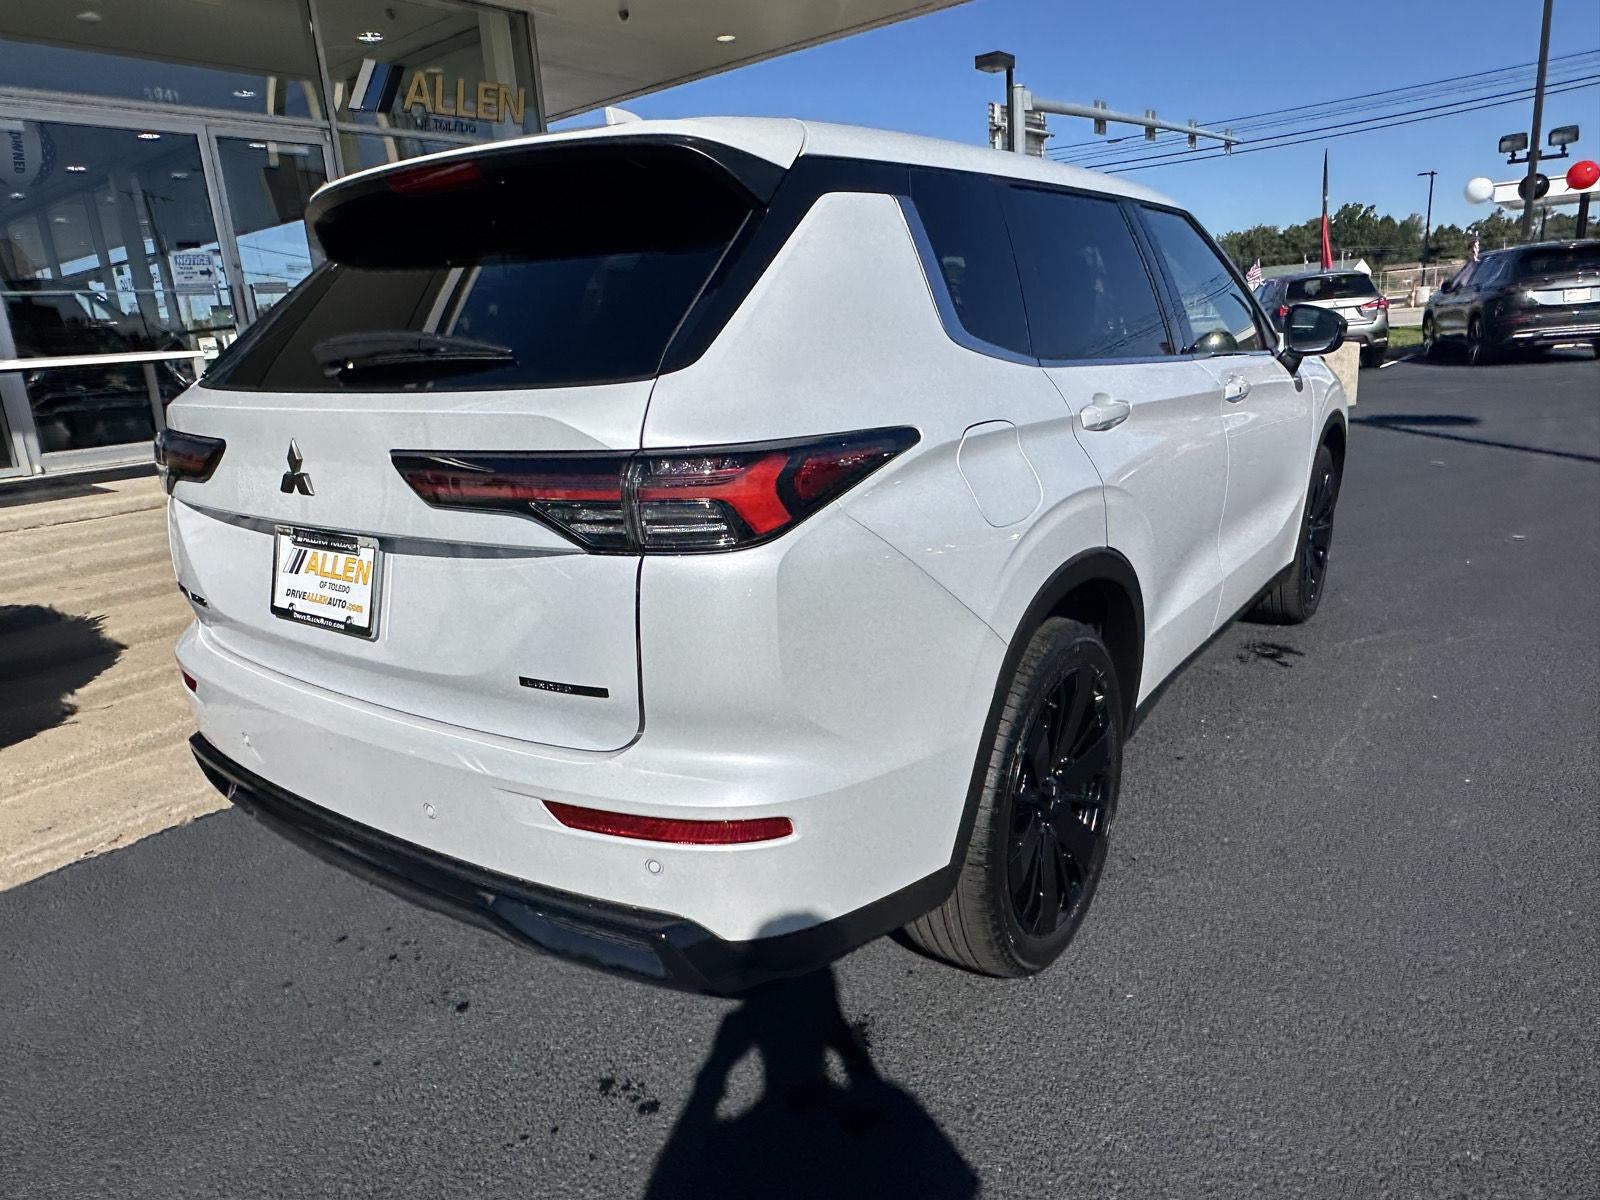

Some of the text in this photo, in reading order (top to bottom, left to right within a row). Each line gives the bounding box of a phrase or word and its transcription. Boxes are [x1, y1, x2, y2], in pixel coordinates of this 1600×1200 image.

[403, 69, 525, 125] ALLEN
[304, 551, 372, 586] ALLEN
[319, 580, 351, 594] OF TOLEDO
